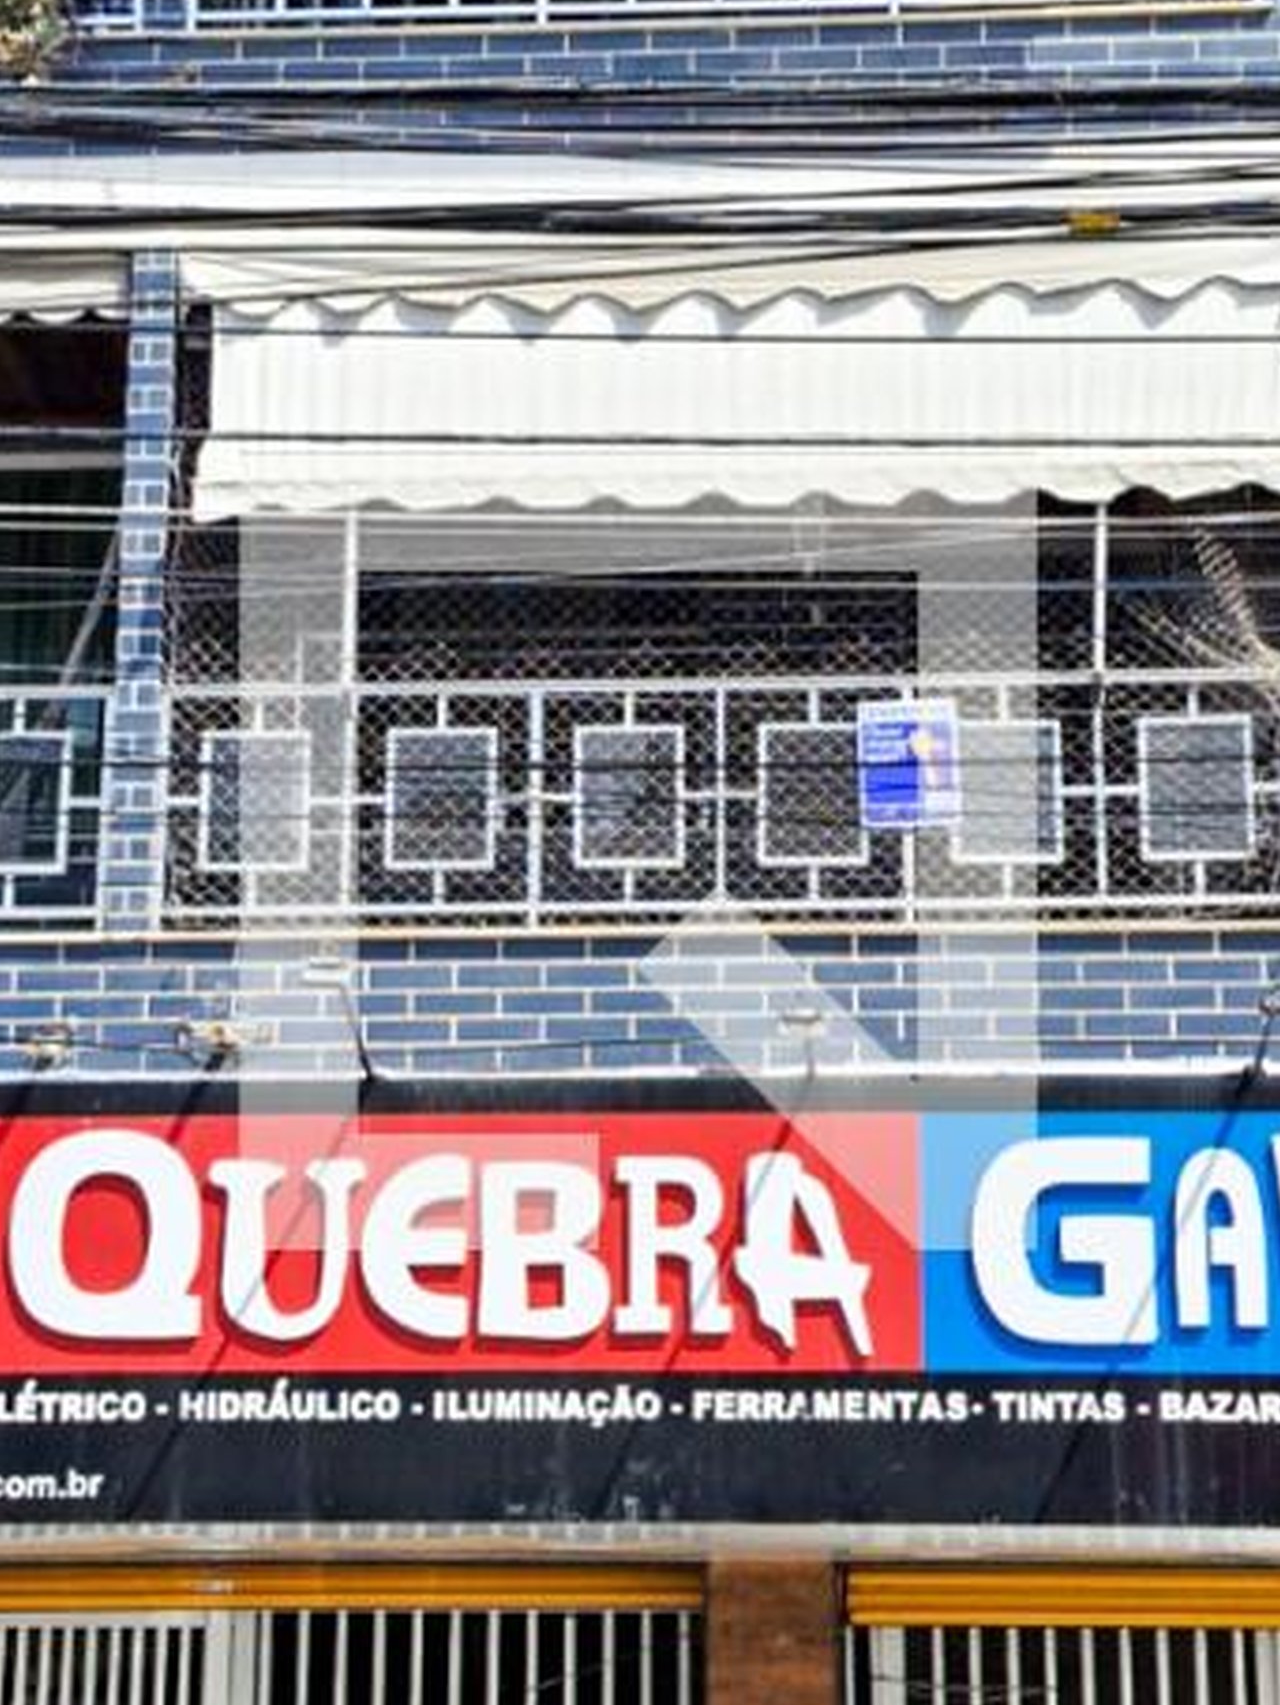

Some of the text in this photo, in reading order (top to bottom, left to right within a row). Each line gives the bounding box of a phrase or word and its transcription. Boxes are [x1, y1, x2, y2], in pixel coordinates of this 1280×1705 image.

[6, 1127, 876, 1359] QUEBRA
[178, 1377, 401, 1422] HIDRÁULICO
[432, 1384, 663, 1428] ILUMINAÇÃO
[990, 1390, 1127, 1423] TINTAS
